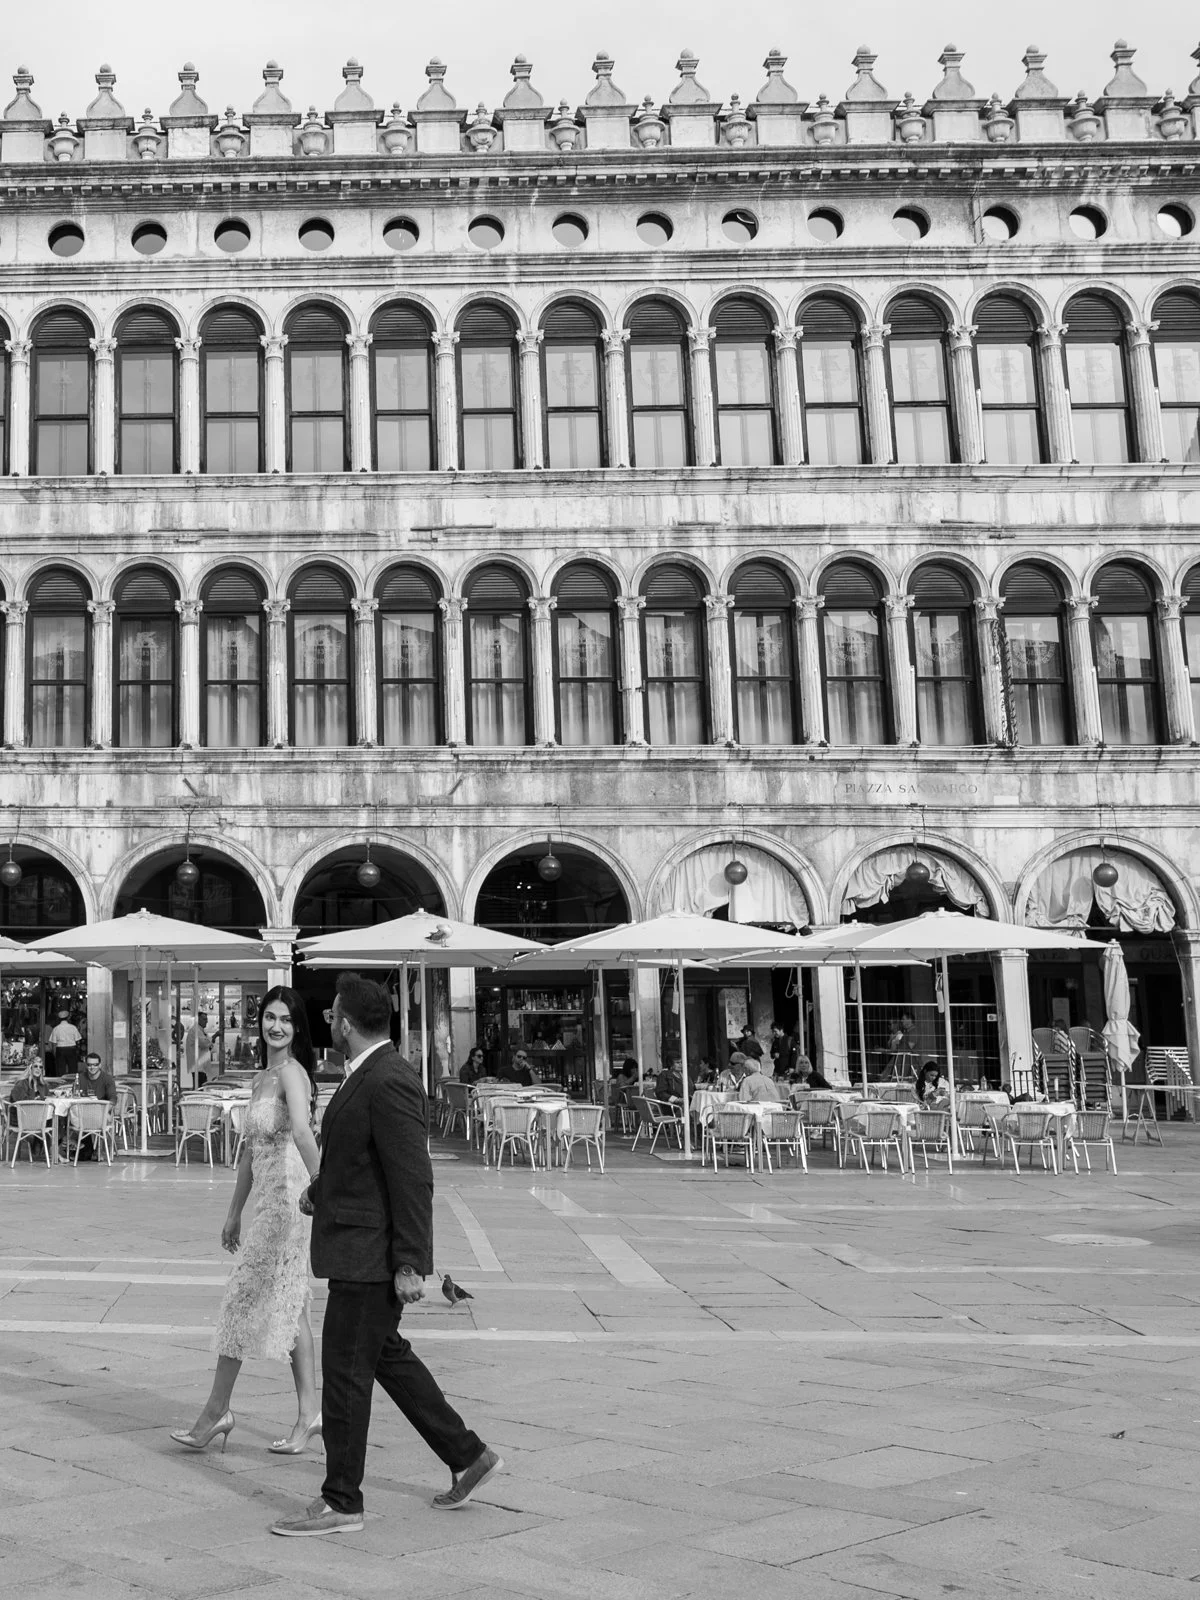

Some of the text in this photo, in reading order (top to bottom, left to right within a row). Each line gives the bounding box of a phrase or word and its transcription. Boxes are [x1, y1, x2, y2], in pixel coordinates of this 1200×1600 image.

[845, 783, 978, 794] PIAZZA SAN MARCO
